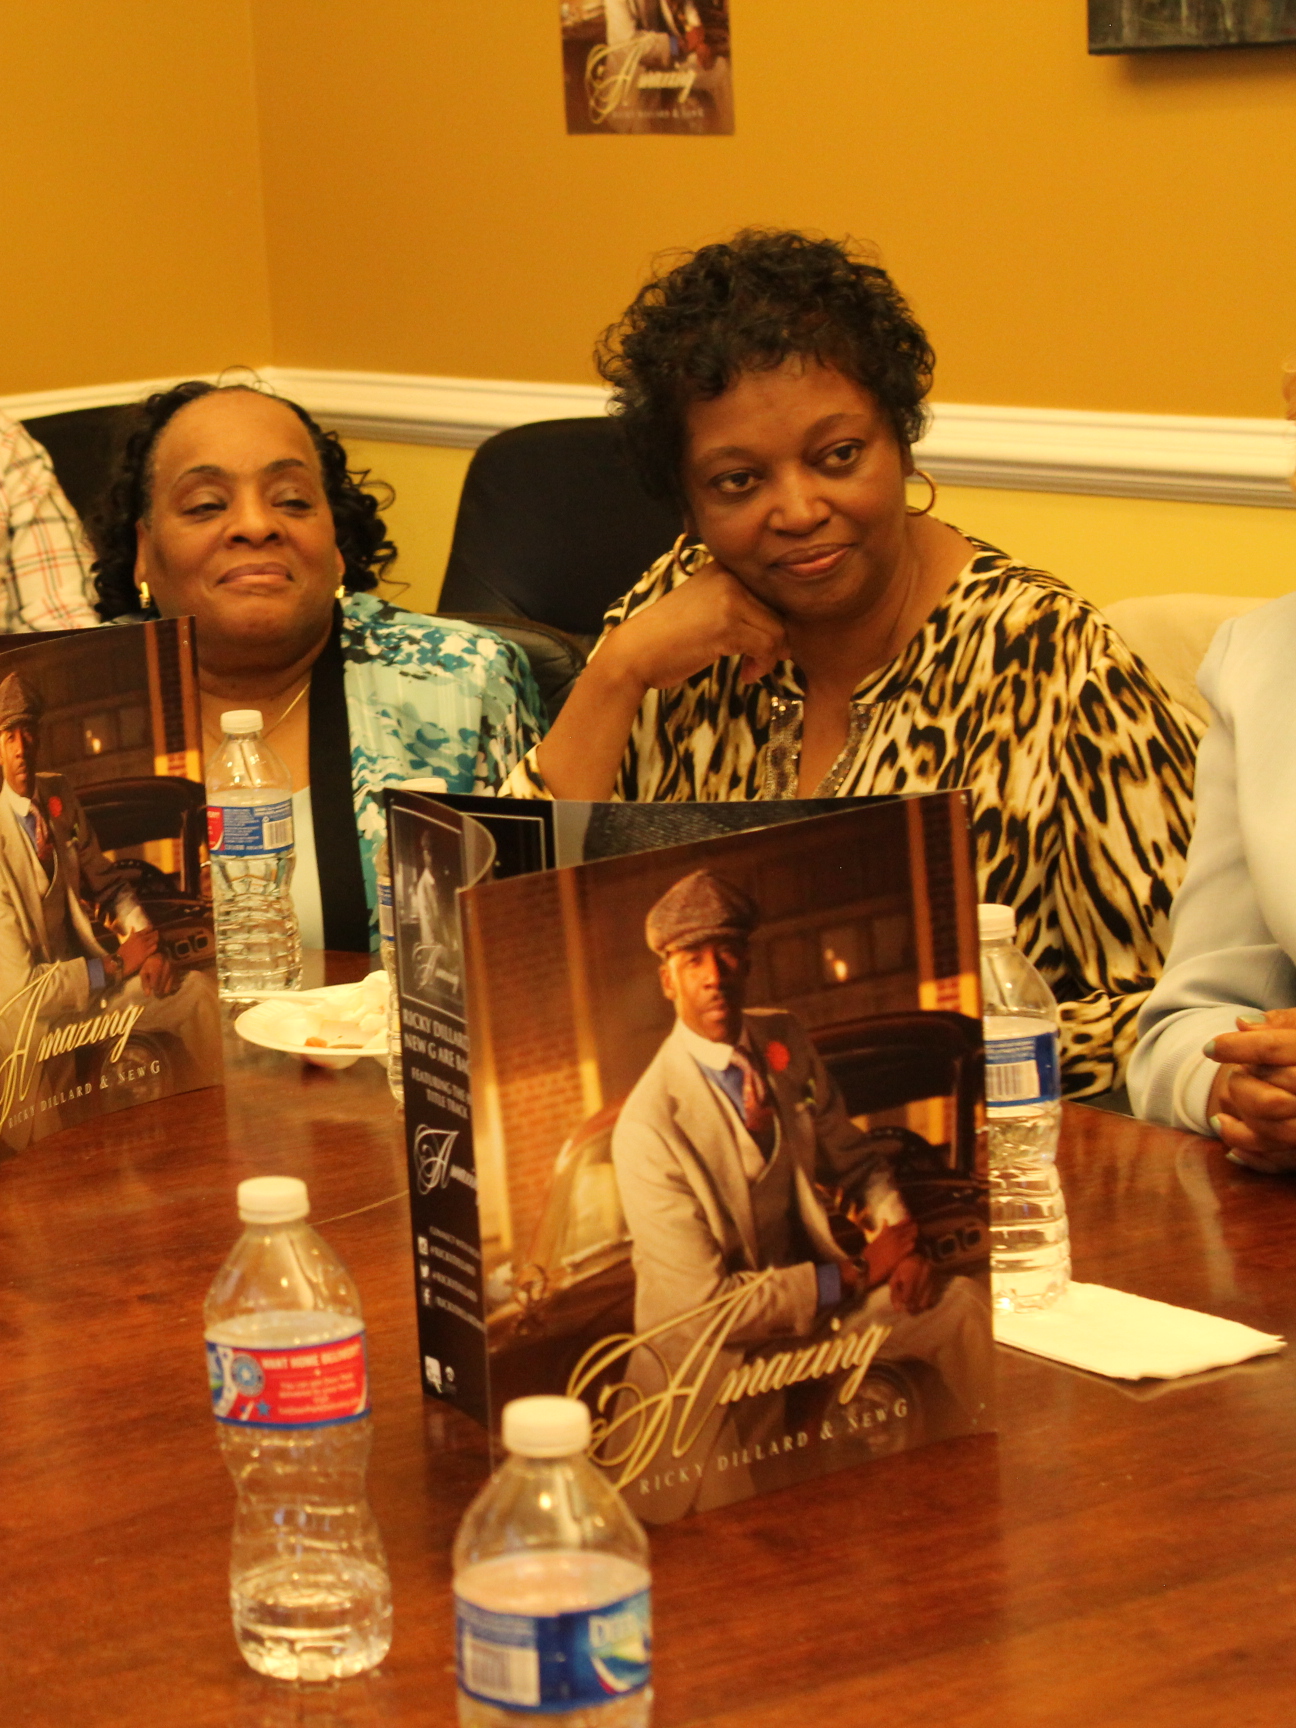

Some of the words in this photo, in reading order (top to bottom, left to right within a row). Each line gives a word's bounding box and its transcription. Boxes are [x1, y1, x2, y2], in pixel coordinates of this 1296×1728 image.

[8, 1105, 36, 1129] RICKY
[40, 1082, 93, 1113] DILLARD
[99, 1074, 109, 1090] &
[117, 1065, 146, 1085] NEW
[150, 1060, 161, 1075] G
[567, 1266, 892, 1490] Amazing
[638, 1464, 703, 1495] RICKY
[717, 1432, 808, 1472] DILLARD
[820, 1420, 833, 1440] &
[848, 1408, 887, 1433] NEW
[894, 1397, 908, 1419] G
